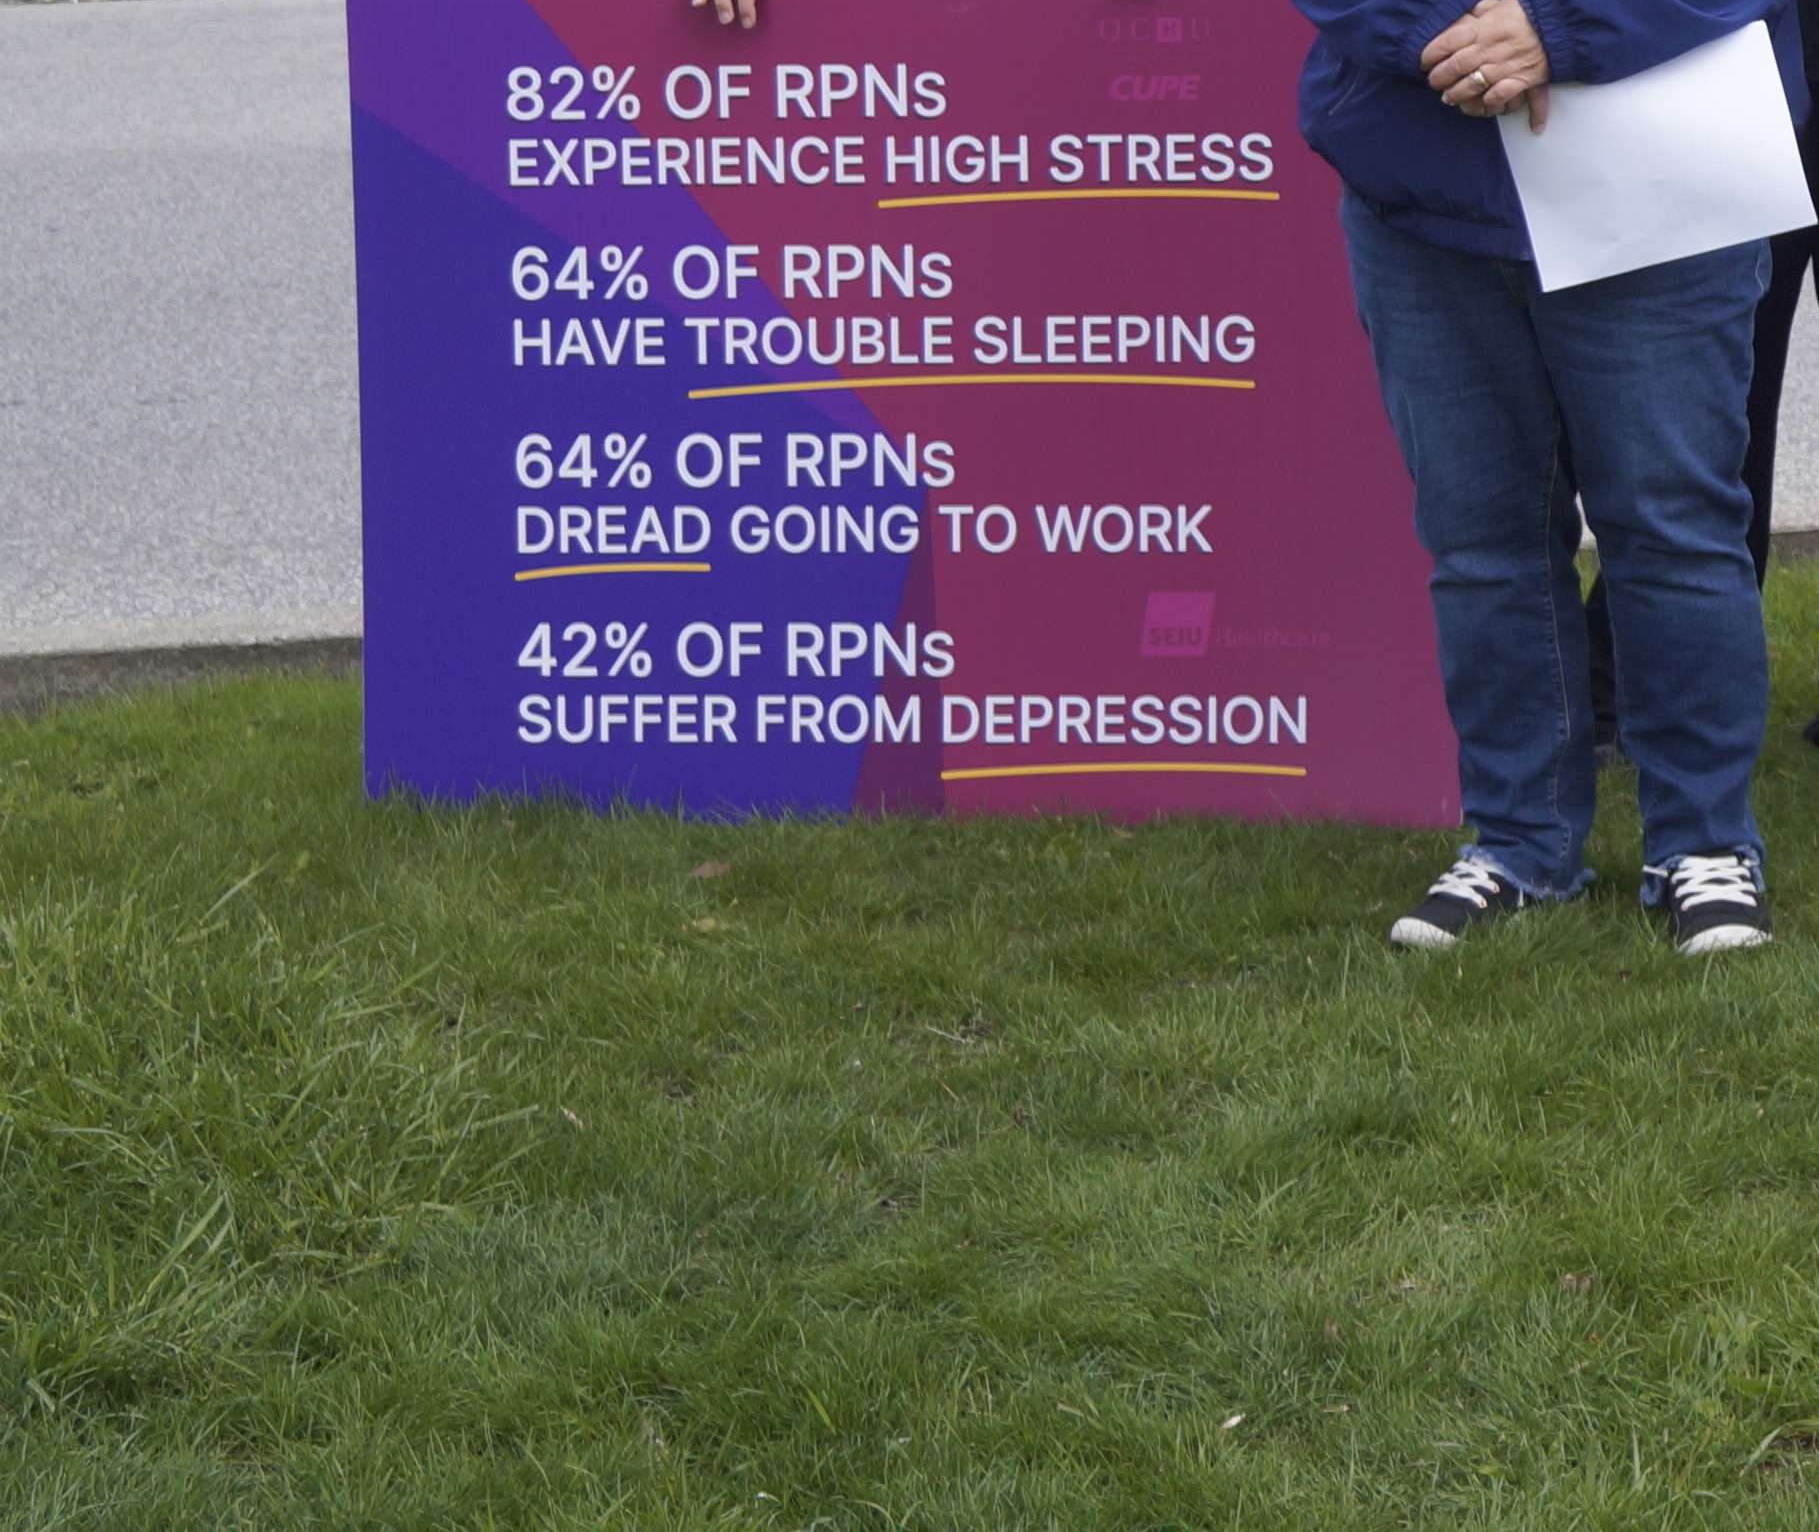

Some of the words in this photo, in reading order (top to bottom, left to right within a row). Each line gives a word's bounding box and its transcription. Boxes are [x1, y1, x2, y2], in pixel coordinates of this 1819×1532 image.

[505, 64, 642, 122] 82%
[664, 64, 753, 121] OF
[775, 62, 948, 119] RPNs
[1108, 74, 1202, 101] CUPE
[507, 135, 867, 187] EXPERIENCE
[885, 134, 1030, 184] HIGH
[1048, 132, 1275, 184] STRESS
[510, 244, 650, 302] 64%
[671, 244, 760, 301] OF
[782, 242, 954, 300] RPNs
[512, 316, 667, 367] HAVE
[682, 315, 955, 366] TROUBLE
[972, 314, 1256, 365] SLEEPING
[514, 432, 653, 490] 64%
[675, 432, 764, 489] OF
[785, 432, 956, 489] RPNs
[516, 504, 712, 555] DREAD
[729, 504, 920, 555] GOING
[937, 504, 1018, 554] TO
[1034, 503, 1214, 554] WORK
[517, 620, 653, 679] 42%
[675, 621, 764, 679] OF
[786, 621, 956, 679] RPNs
[1148, 626, 1204, 647] SEIU
[517, 693, 739, 744] SUFFER
[756, 693, 922, 745] FROM
[941, 694, 1308, 746] DEPRESSION
